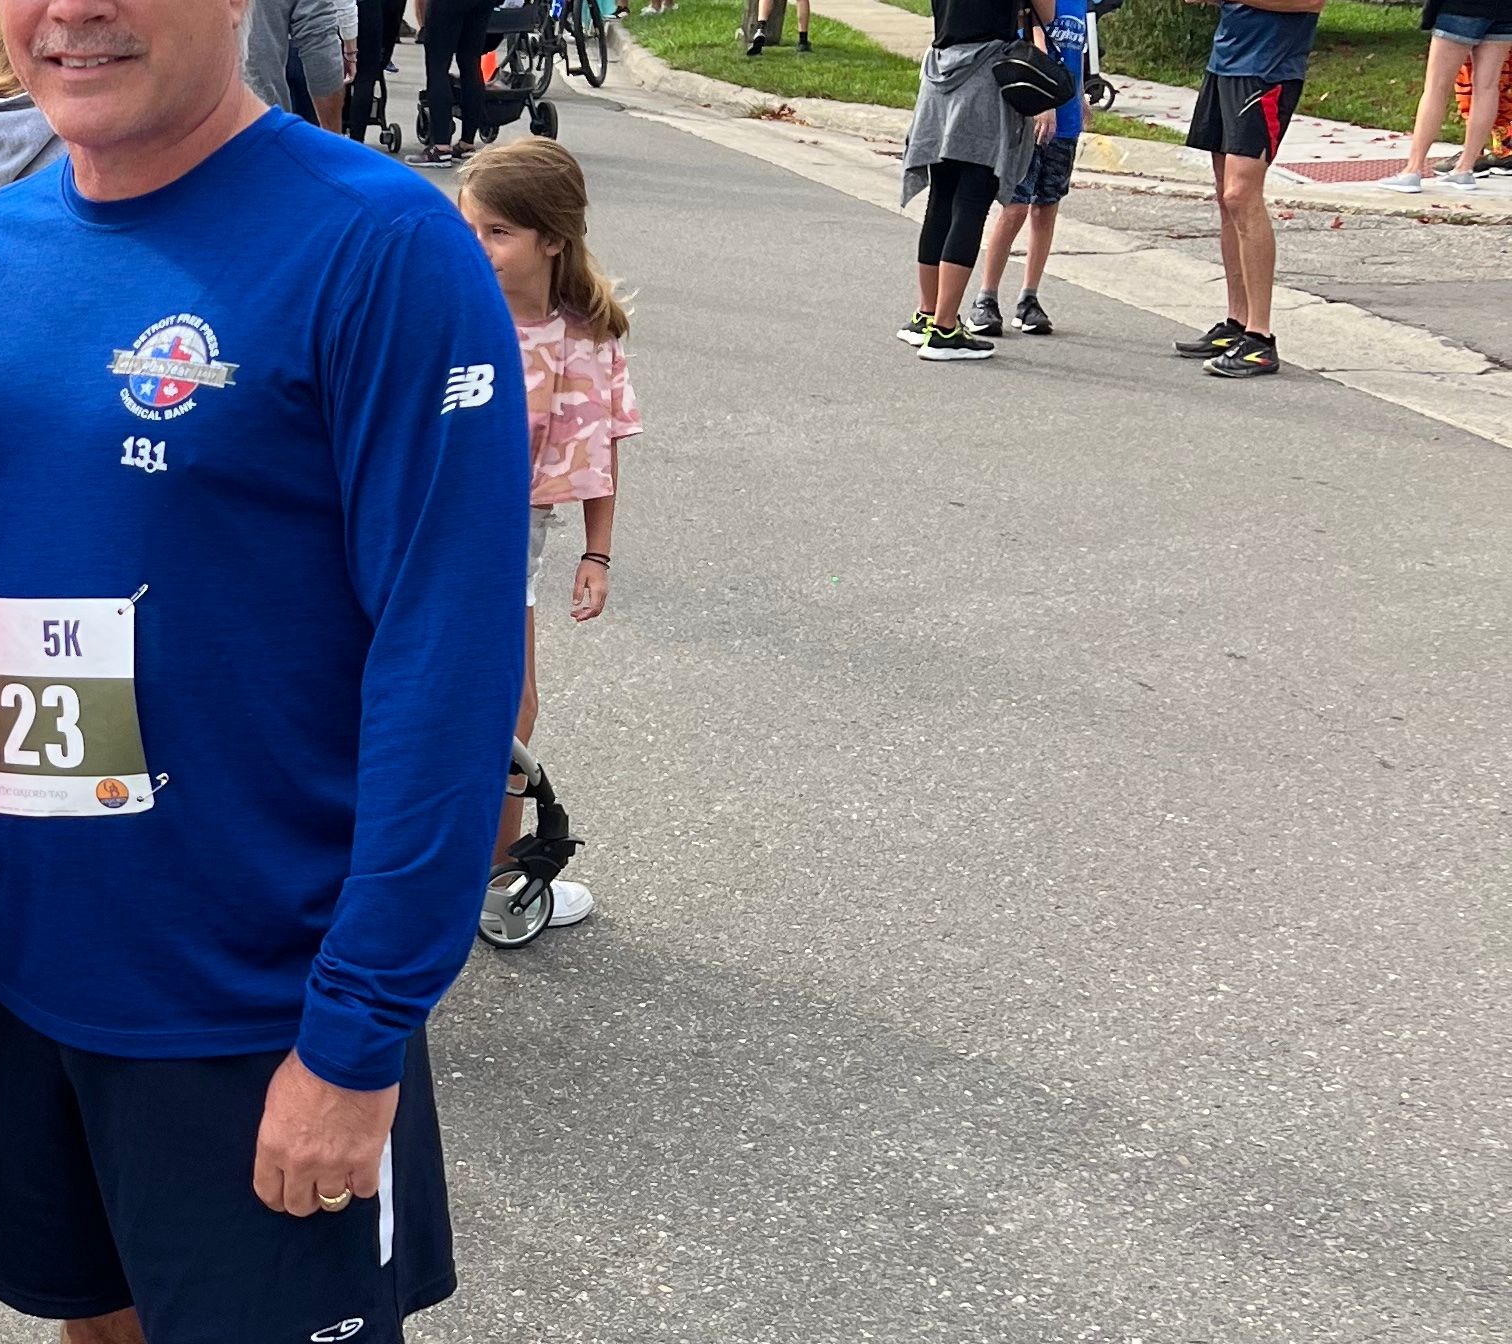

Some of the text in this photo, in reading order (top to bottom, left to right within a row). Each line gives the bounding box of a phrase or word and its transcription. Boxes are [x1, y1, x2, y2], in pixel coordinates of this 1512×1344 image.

[133, 313, 219, 357] DETROIT FREE PRESS
[120, 388, 197, 420] CHEMICAL BANK
[43, 619, 83, 657] 5K
